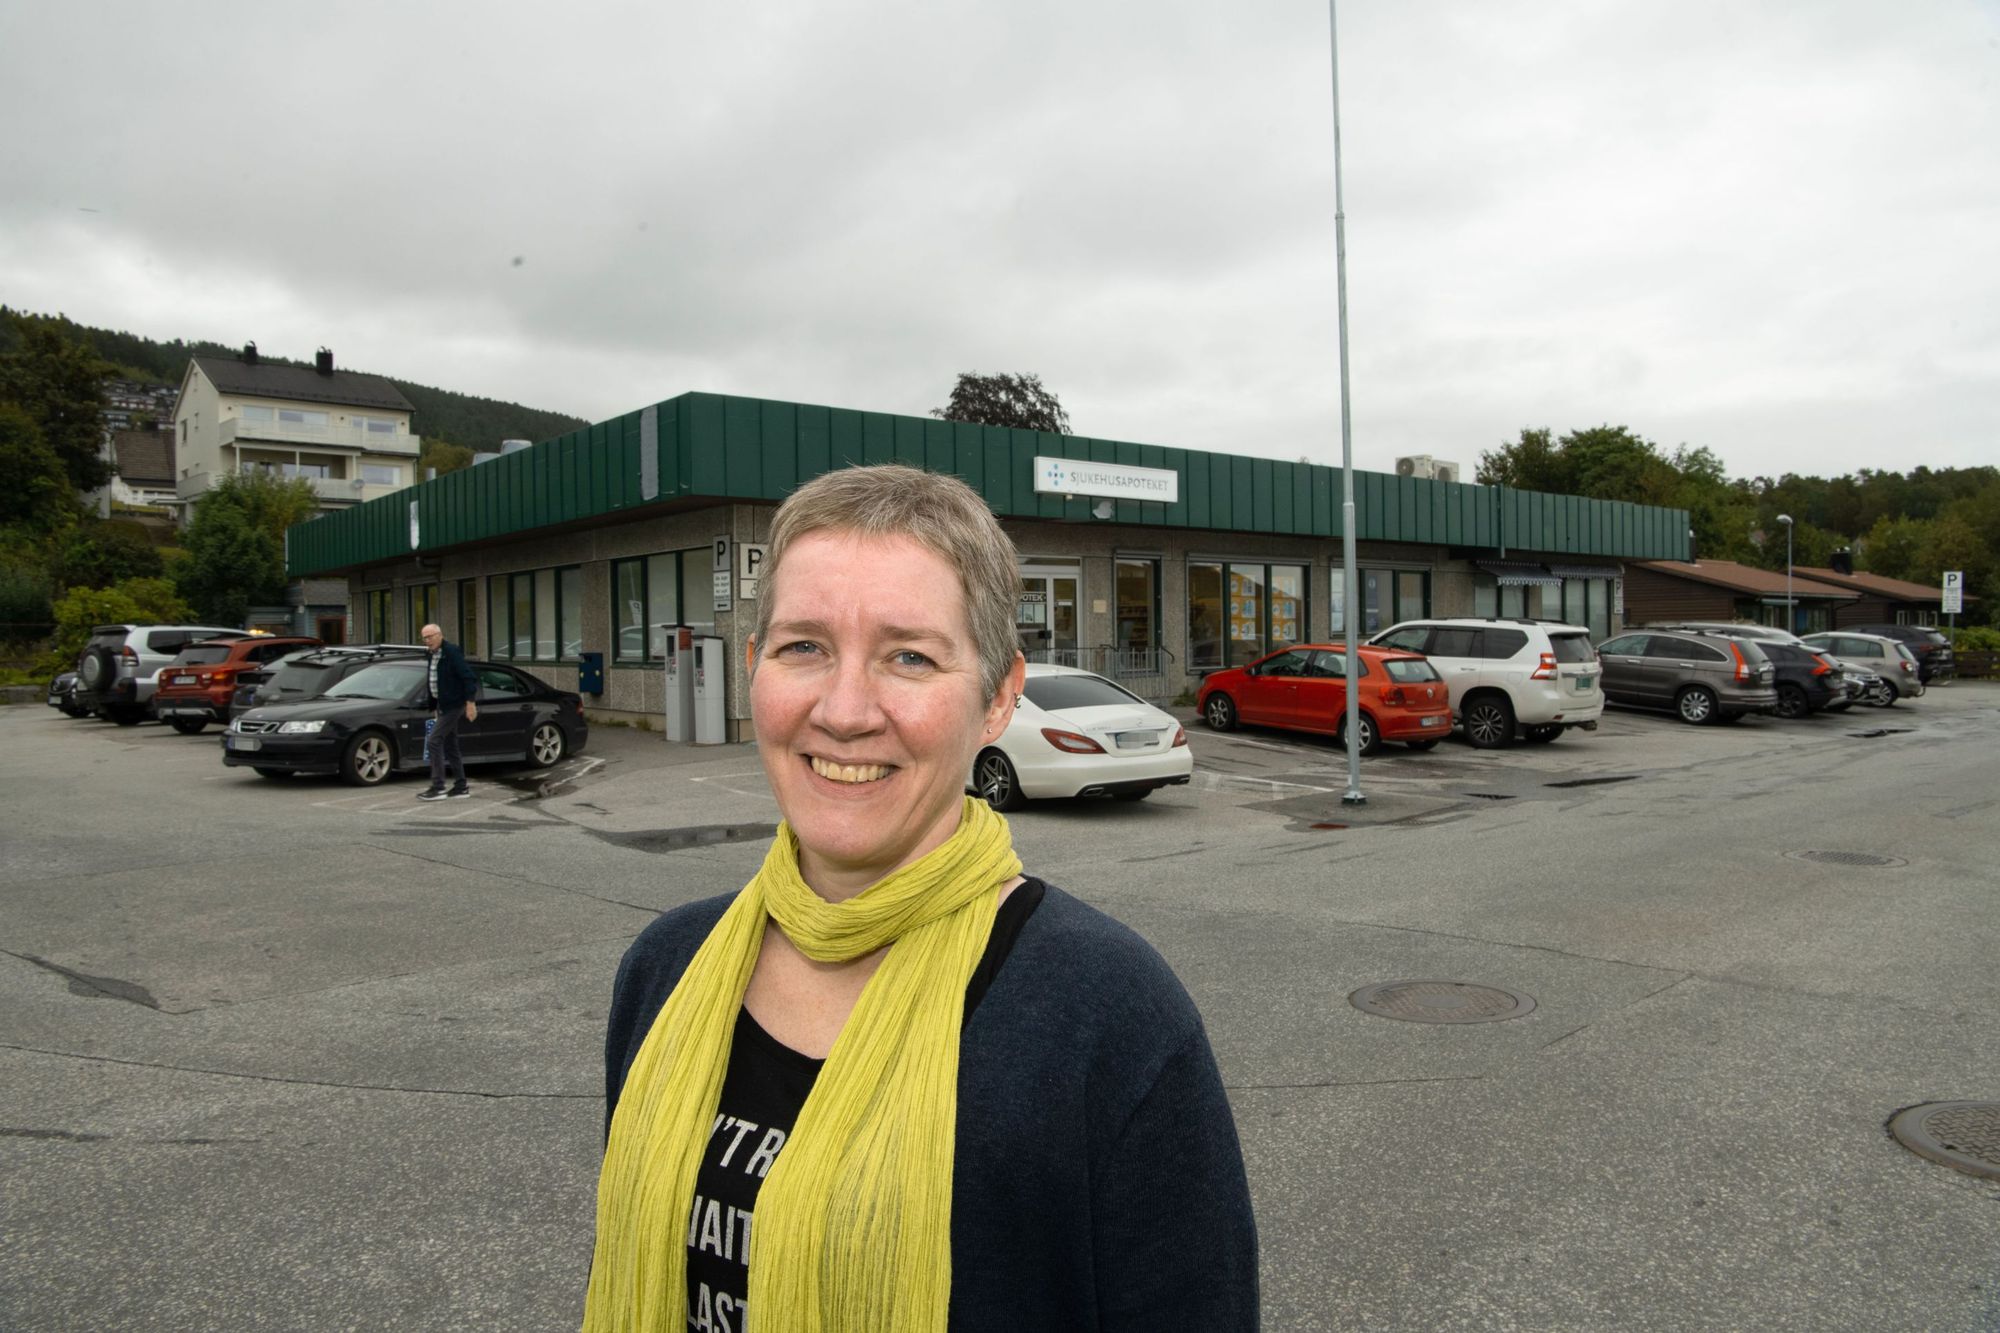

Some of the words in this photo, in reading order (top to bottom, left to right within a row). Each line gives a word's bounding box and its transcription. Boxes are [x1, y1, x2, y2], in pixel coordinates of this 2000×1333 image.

[1070, 472, 1168, 491] SJUKEHUSAPOTEKET
[717, 541, 726, 566] P
[748, 549, 763, 574] P
[1947, 574, 1958, 586] P
[1019, 593, 1043, 601] OTEK
[688, 1195, 753, 1266] AIT
